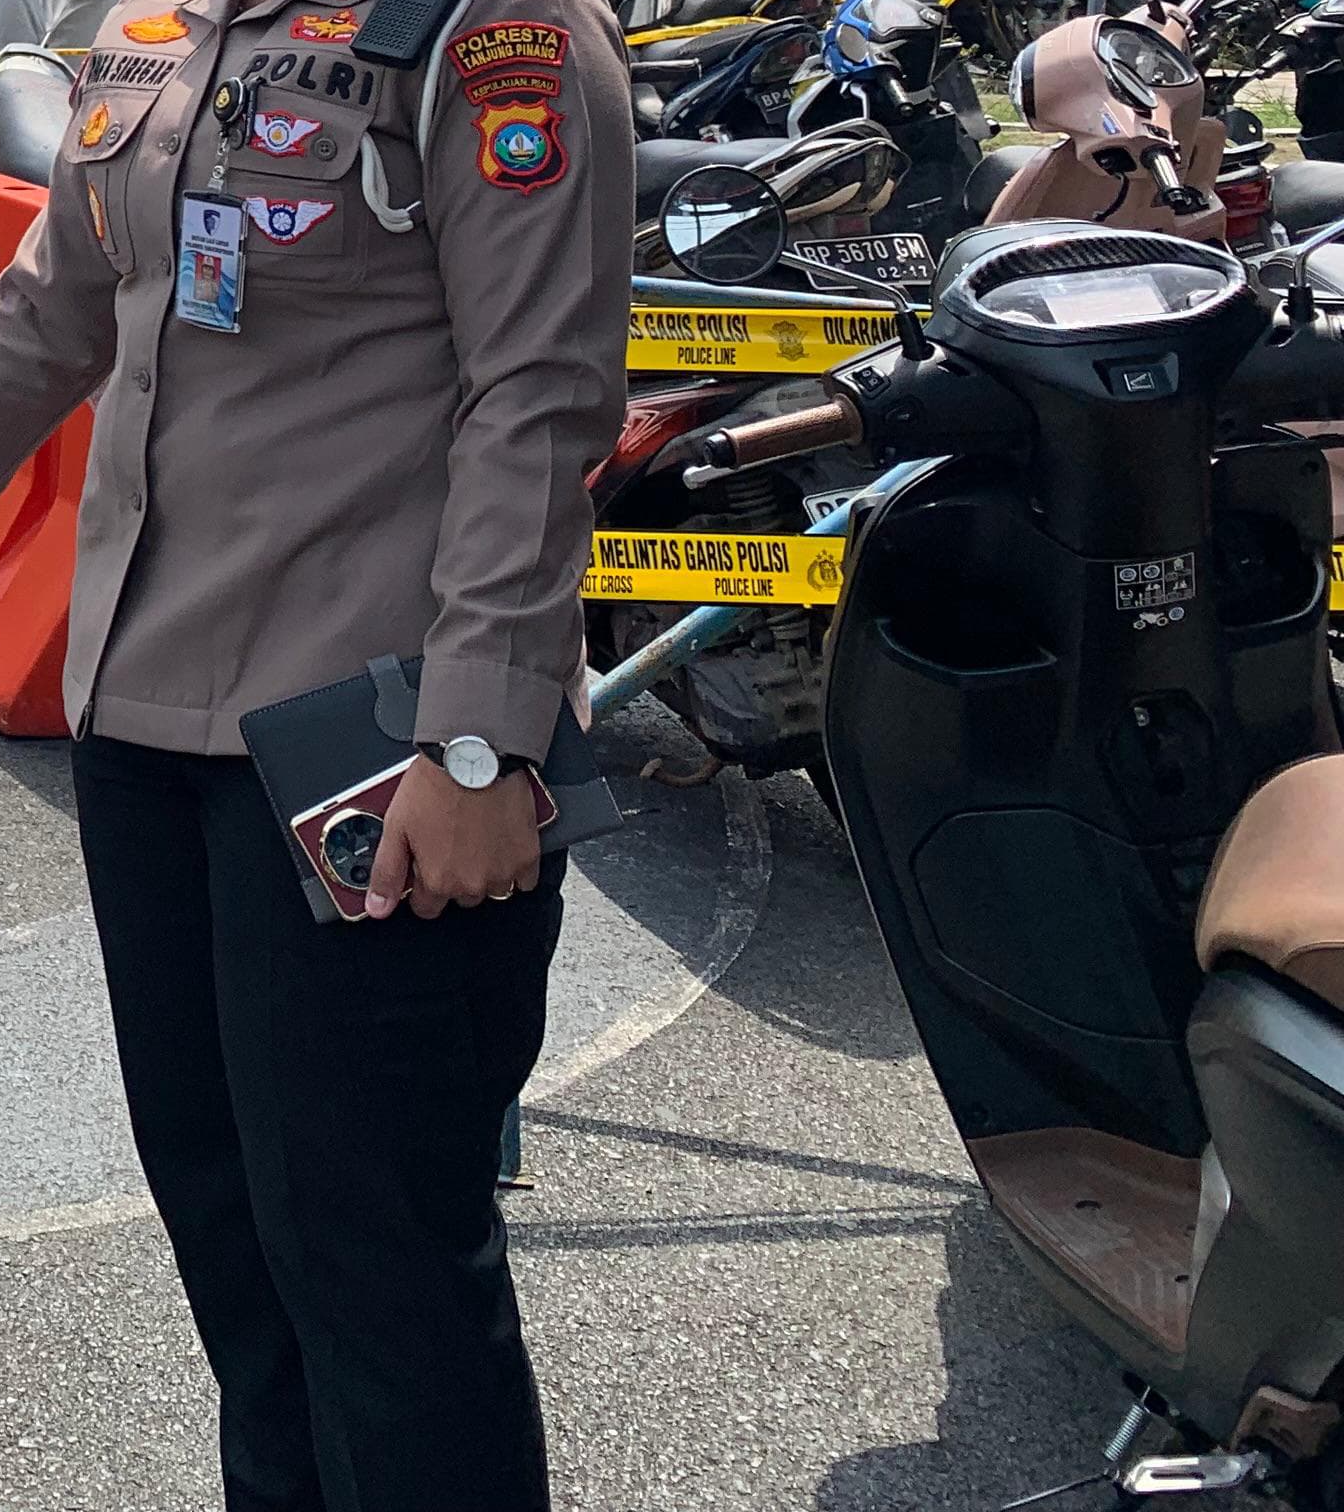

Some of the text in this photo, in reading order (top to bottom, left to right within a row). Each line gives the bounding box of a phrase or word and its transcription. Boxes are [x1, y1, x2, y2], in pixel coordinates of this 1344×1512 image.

[455, 27, 559, 59] POLRESTA
[462, 43, 556, 70] TANJUNG PINANG
[241, 53, 374, 106] POLRI
[473, 77, 528, 99] KEPULAUAN
[895, 237, 924, 261] GM
[644, 314, 696, 341] GARIS
[698, 315, 751, 344] POLISI
[677, 347, 737, 365] POLICE LINE
[600, 538, 679, 571] MELINTAS
[684, 540, 733, 572] GARIS
[737, 541, 790, 573] POLISI
[580, 576, 774, 597] OT CROSS POLICE LINE
